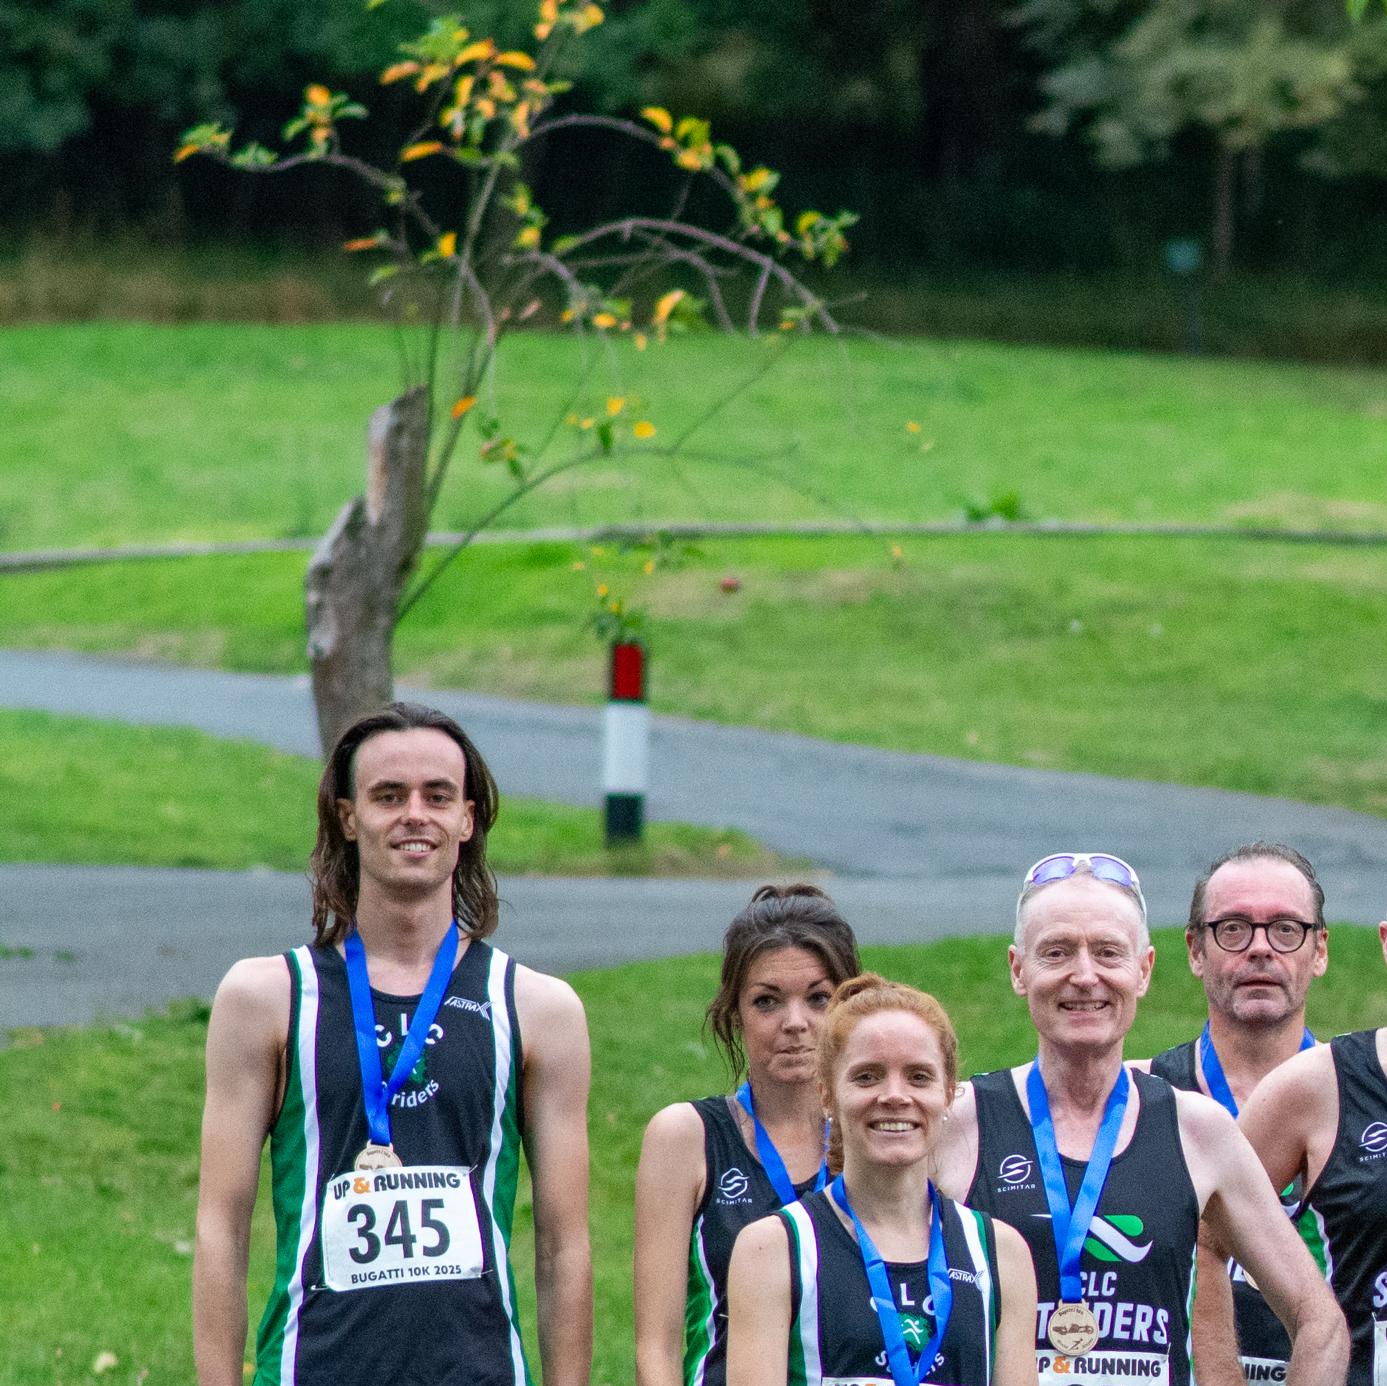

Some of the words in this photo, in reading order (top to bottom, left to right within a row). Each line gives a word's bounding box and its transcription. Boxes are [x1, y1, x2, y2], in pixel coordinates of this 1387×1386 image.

[382, 1080, 439, 1108] riders
[333, 1180, 350, 1200] UP
[353, 1177, 371, 1194] &
[374, 1172, 461, 1192] RUNNING
[347, 1198, 450, 1264] 345
[351, 1268, 404, 1284] BUGATTI
[408, 1266, 430, 1277] 10K
[434, 1264, 462, 1275] 2025
[870, 1283, 936, 1316] LC
[1037, 1302, 1169, 1345] TDERS
[1036, 1357, 1050, 1373] P
[1053, 1356, 1070, 1373] &
[1074, 1357, 1161, 1377] RUNNING
